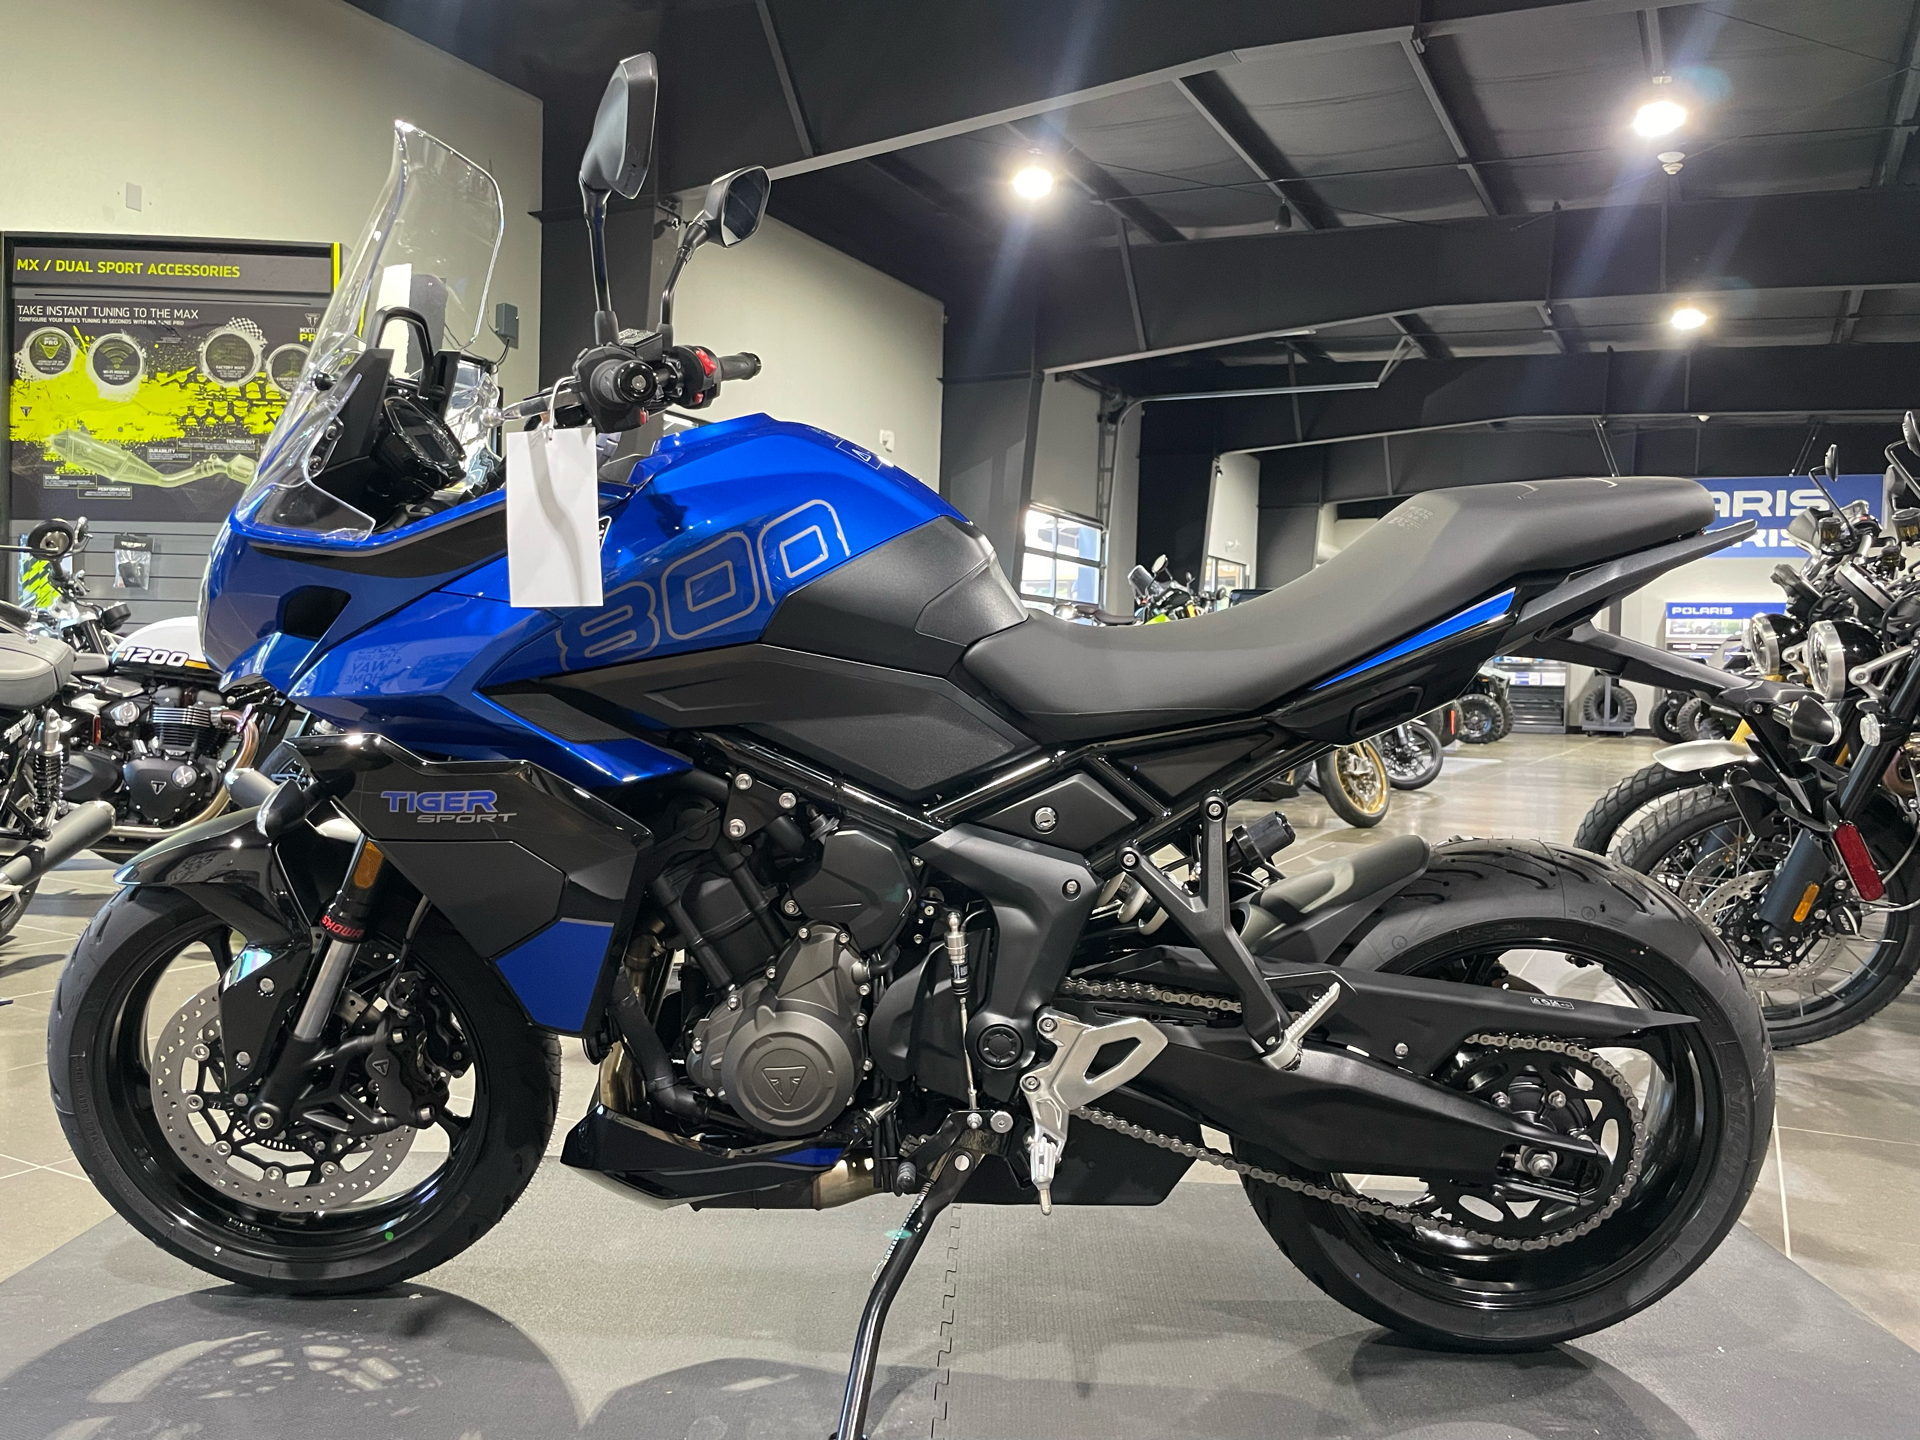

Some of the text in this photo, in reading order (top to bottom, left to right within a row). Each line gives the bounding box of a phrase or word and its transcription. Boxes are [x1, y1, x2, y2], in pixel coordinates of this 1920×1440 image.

[17, 259, 240, 278] MX / DUAL SPORT ACCESSORIES
[17, 305, 199, 320] TAKE INSTANT TUNING TO THE MAX
[299, 333, 317, 342] PR
[1708, 489, 1830, 518] ARIS
[556, 499, 852, 672] 800
[1671, 606, 1734, 615] POLARIS
[121, 646, 191, 667] 1200
[381, 789, 499, 813] TIGER
[416, 812, 518, 824] SPORT
[321, 914, 364, 938] SHOWA
